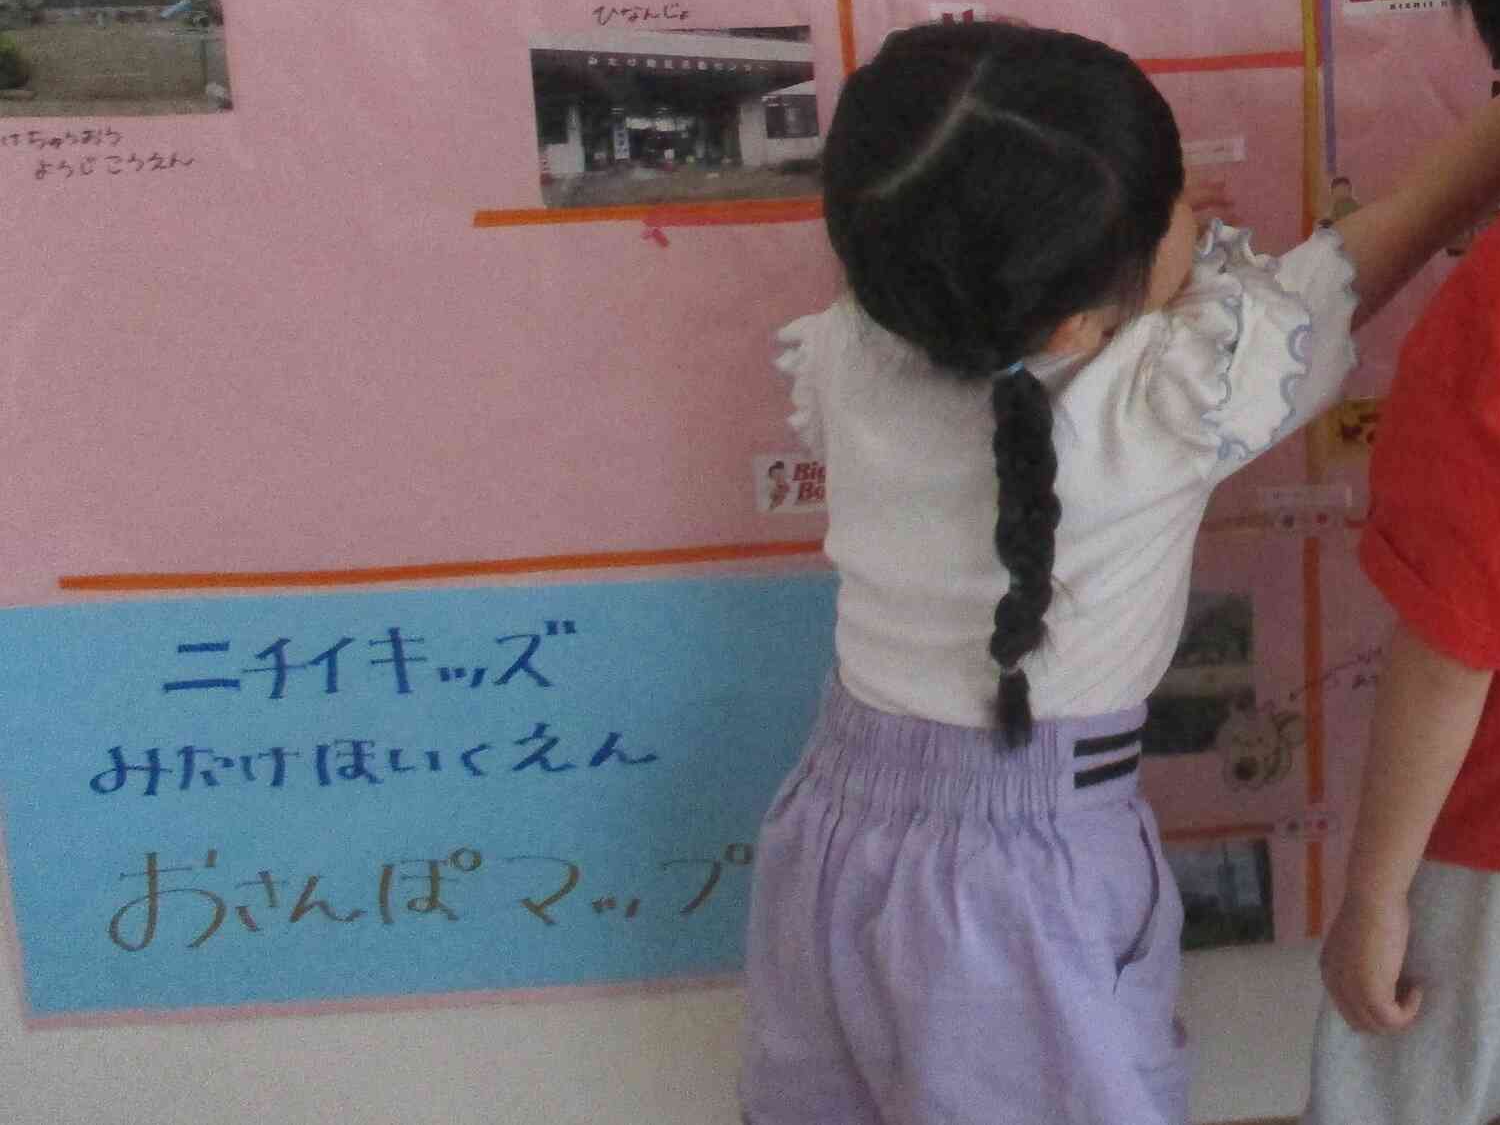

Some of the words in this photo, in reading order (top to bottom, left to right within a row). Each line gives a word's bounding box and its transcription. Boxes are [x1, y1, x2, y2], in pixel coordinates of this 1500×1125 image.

[163, 619, 577, 700] ニチイキッズ
[88, 722, 659, 797] みたけほいくえん
[108, 843, 757, 952] おさんぽマップ
